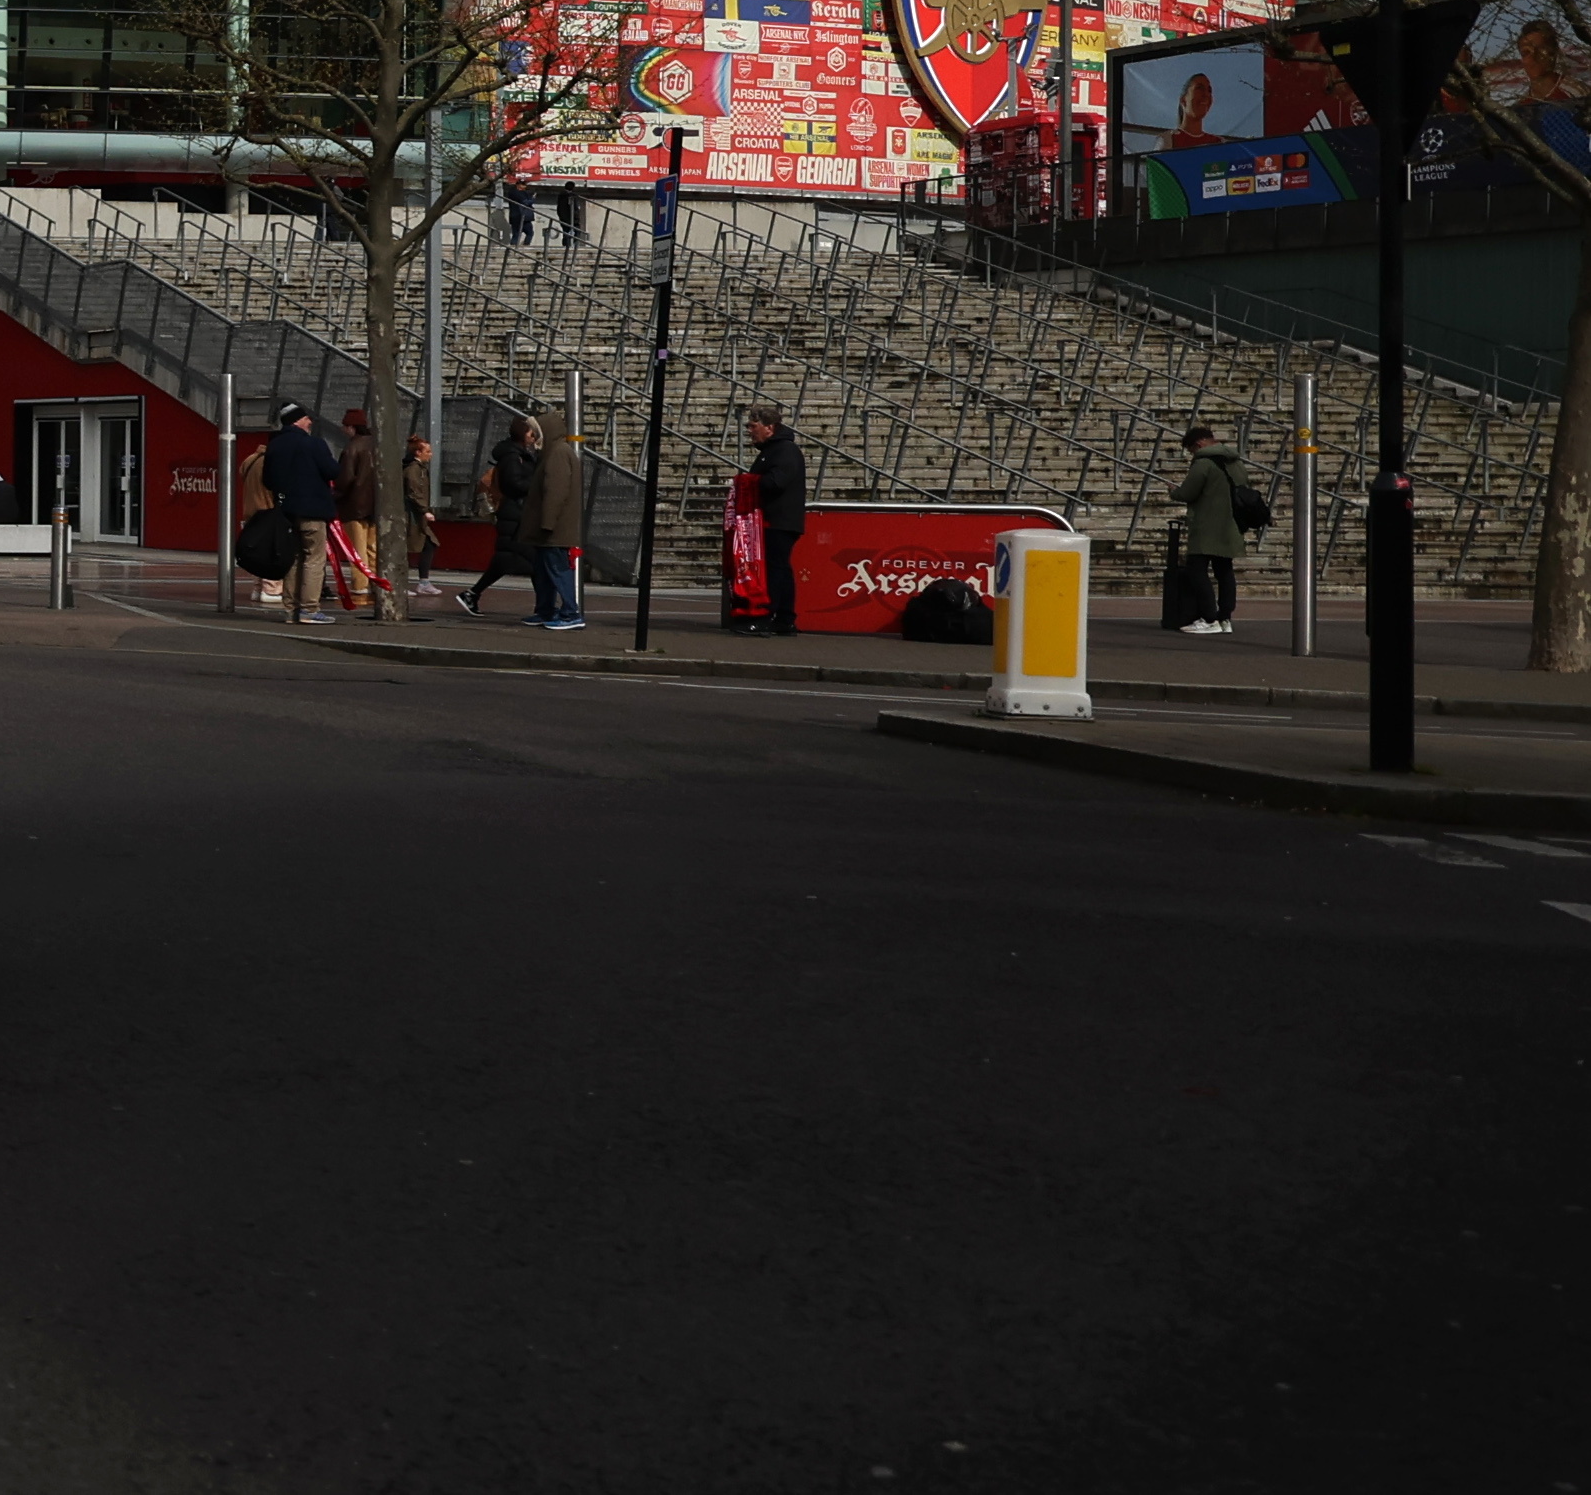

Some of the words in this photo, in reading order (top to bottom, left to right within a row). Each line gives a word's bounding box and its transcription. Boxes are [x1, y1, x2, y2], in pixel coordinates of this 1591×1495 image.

[811, 1, 861, 20] Kerala
[814, 29, 860, 46] Islington
[667, 72, 686, 91] GG
[732, 88, 782, 102] ARSENAL
[597, 145, 637, 154] GUNNERS
[734, 137, 781, 150] CROATIA
[594, 168, 607, 176] ON
[607, 168, 641, 177] WHEELS
[705, 151, 775, 182] ARSENAL
[796, 155, 858, 186] GEORGIA
[868, 159, 896, 175] ARSENAL
[1257, 178, 1279, 188] FedEx
[1414, 171, 1448, 182] LEAGUE
[169, 467, 218, 495] Arsenal
[881, 559, 966, 570] FOREVER
